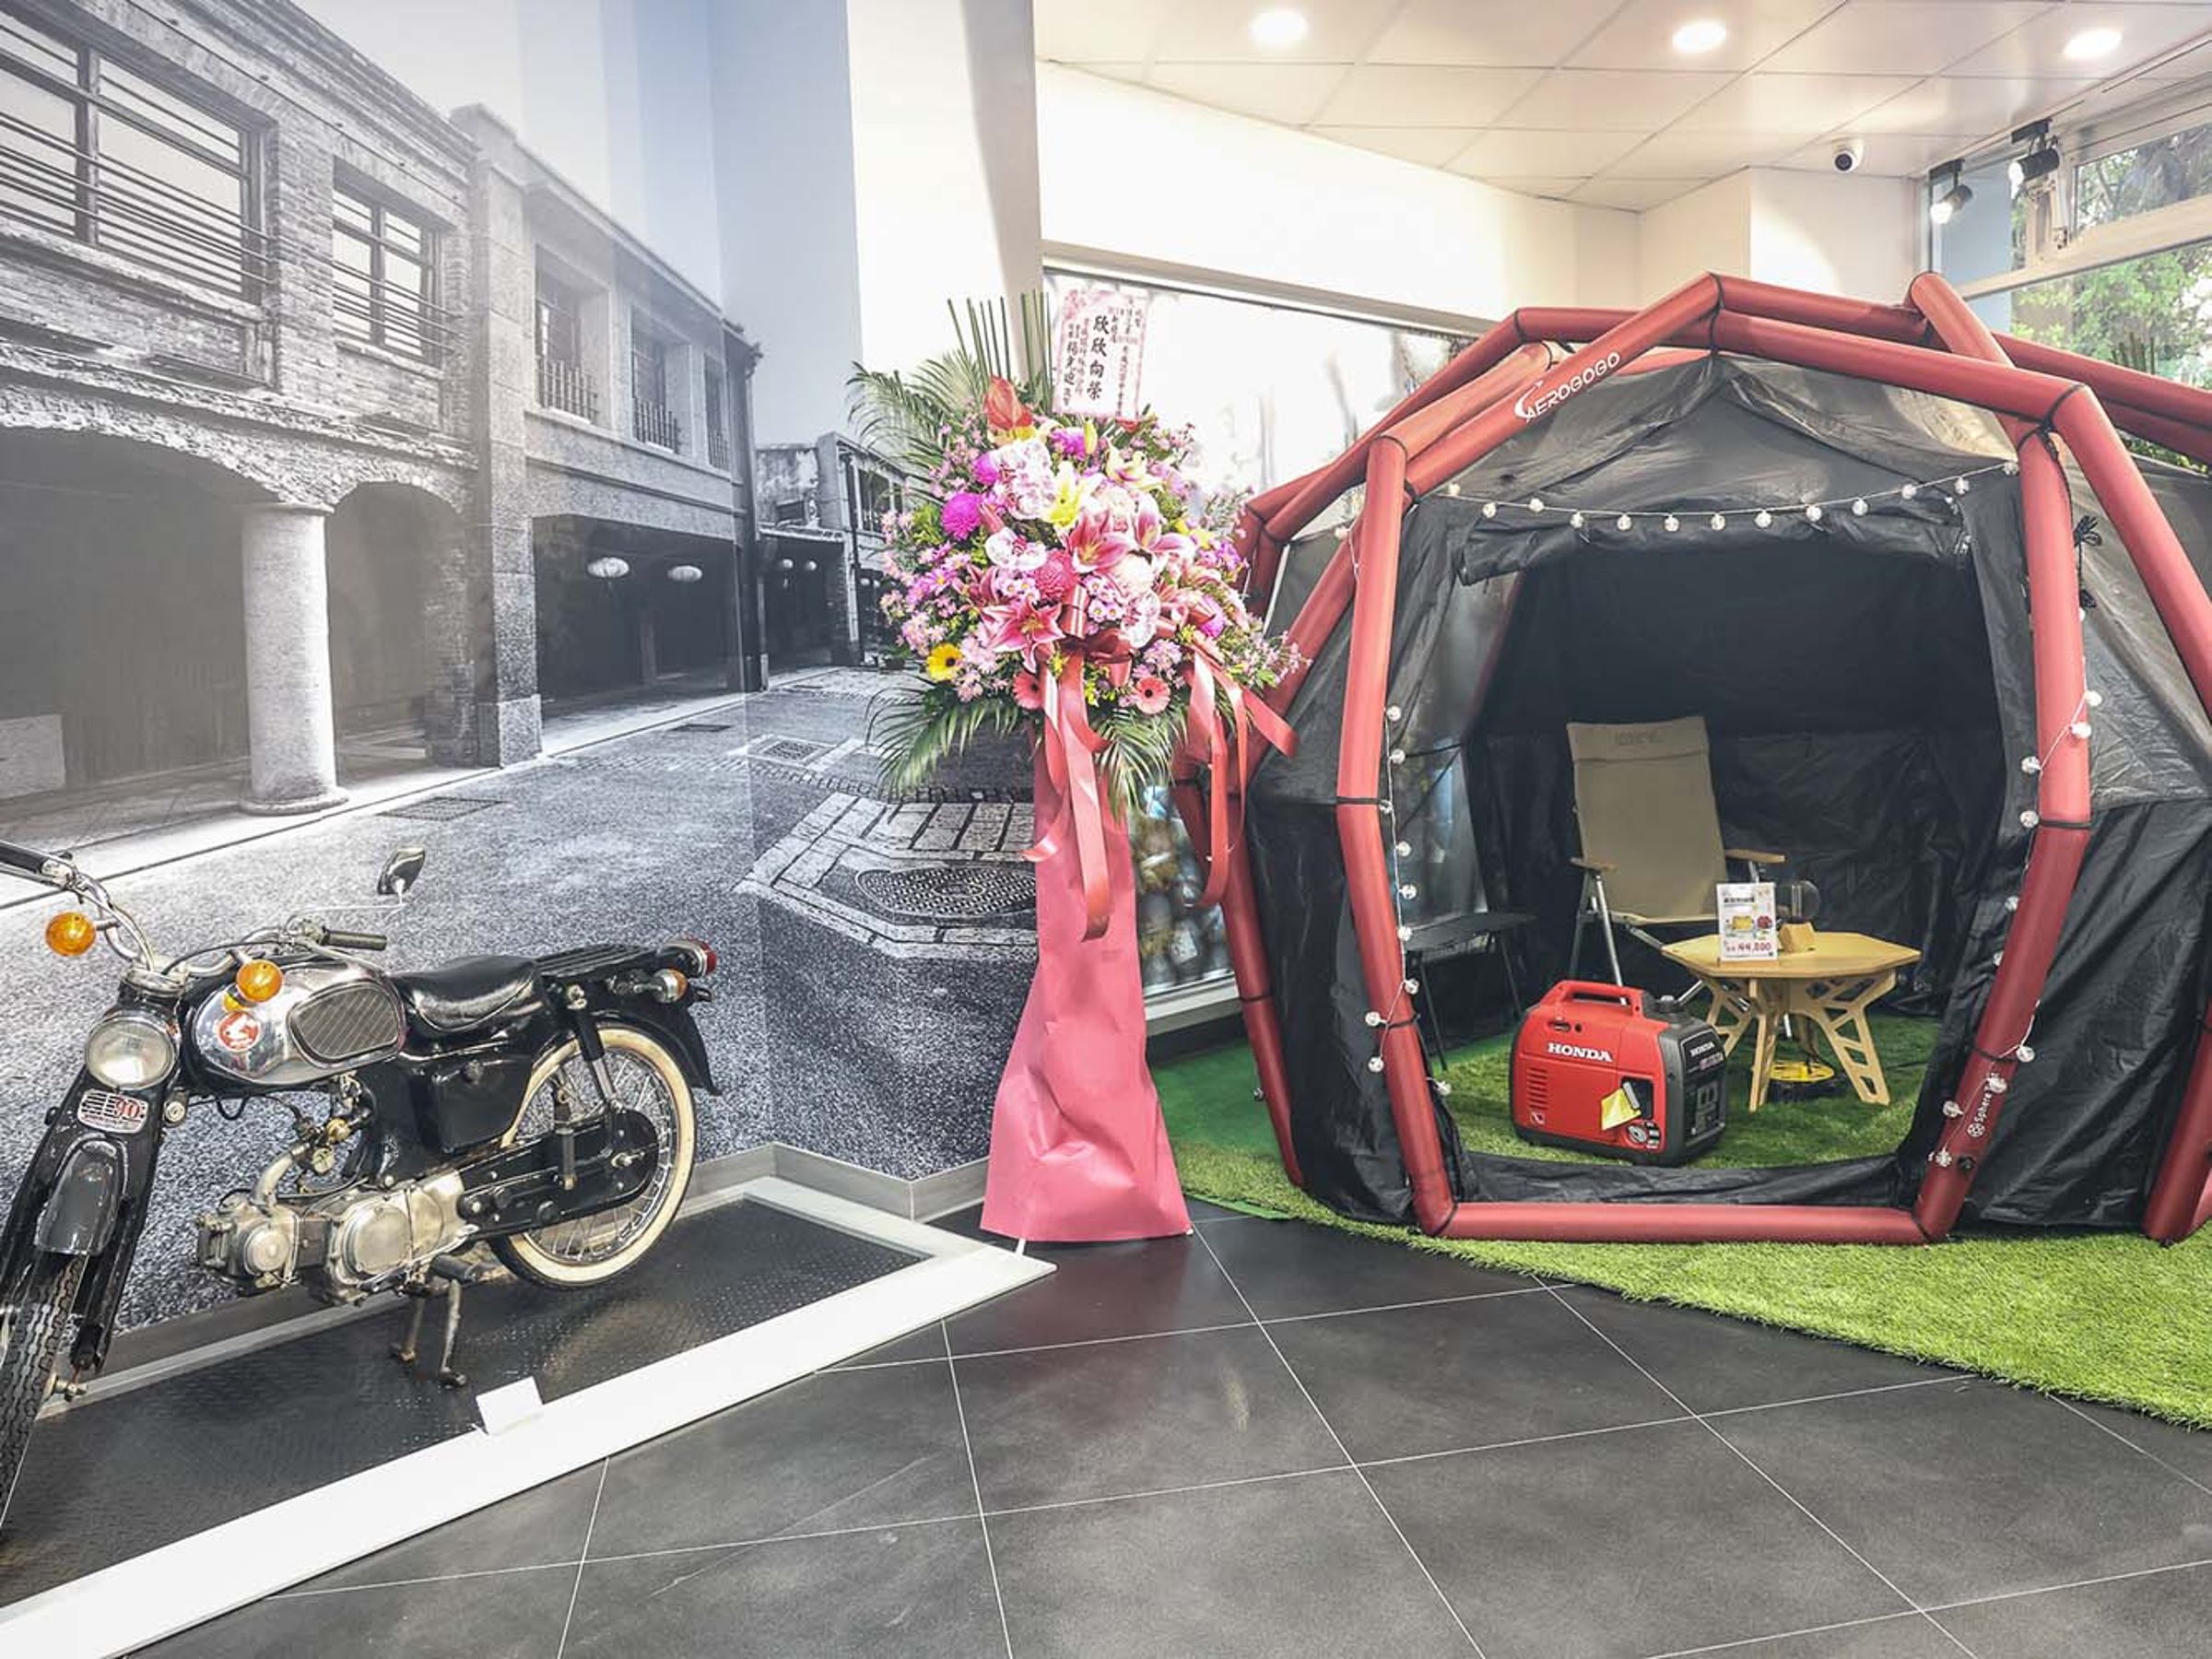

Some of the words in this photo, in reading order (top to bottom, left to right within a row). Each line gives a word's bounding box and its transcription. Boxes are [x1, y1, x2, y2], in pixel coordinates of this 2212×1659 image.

[1087, 314, 1110, 400] 欣欣向榮
[1547, 1042, 1613, 1063] HONDA
[114, 1097, 140, 1119] 90
